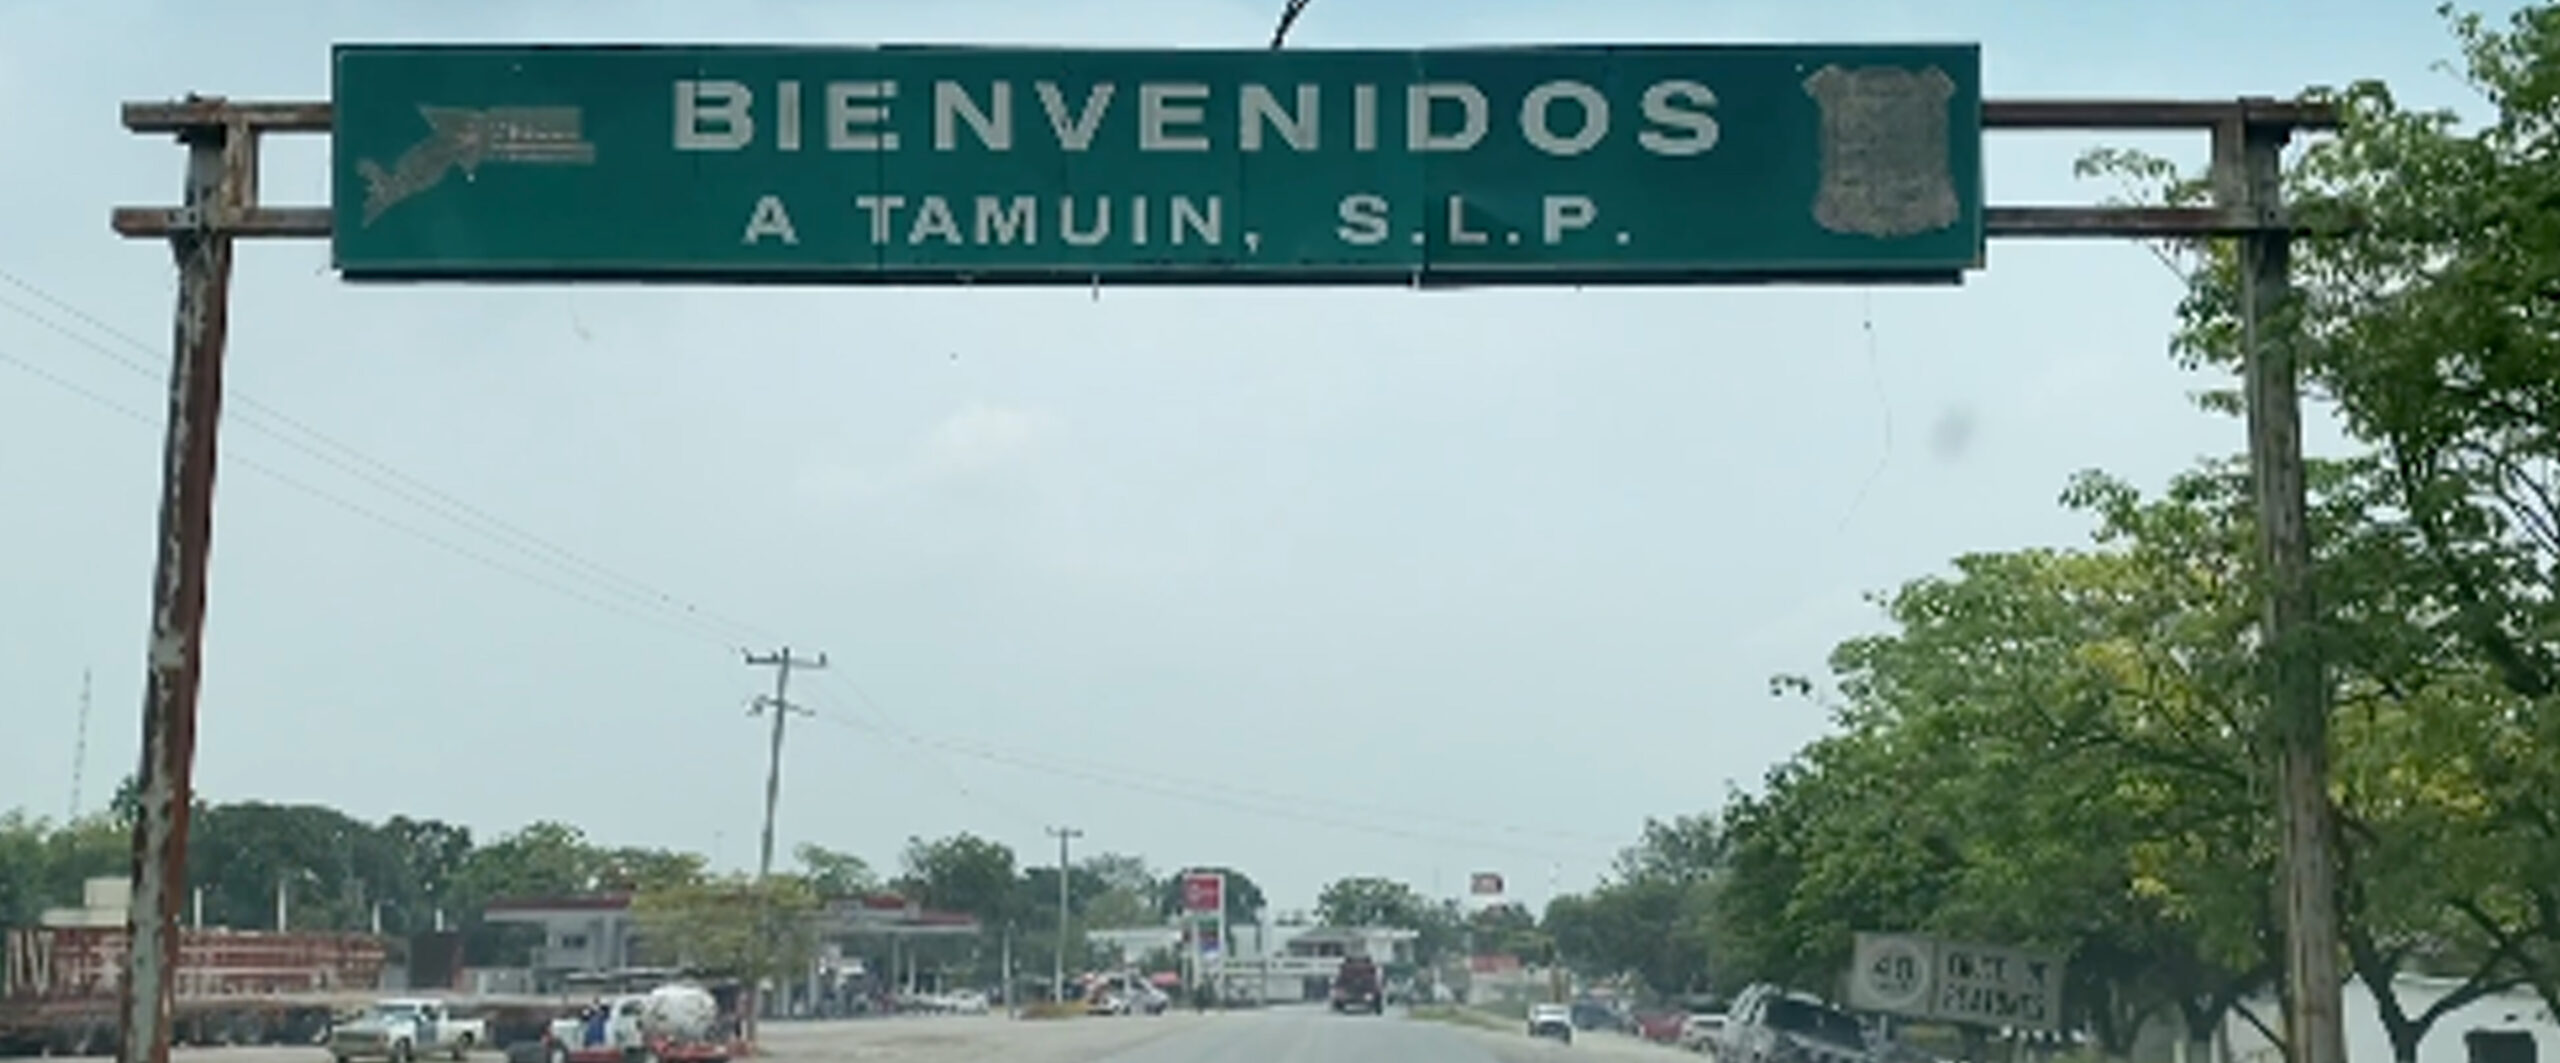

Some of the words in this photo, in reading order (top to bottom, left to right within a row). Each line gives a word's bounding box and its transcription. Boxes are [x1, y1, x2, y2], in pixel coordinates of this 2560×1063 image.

[673, 80, 1722, 156] BIENVENIDOS
[744, 196, 797, 245] A
[855, 196, 1262, 252] TAMUIN,
[1337, 194, 1632, 246] S.L.P.
